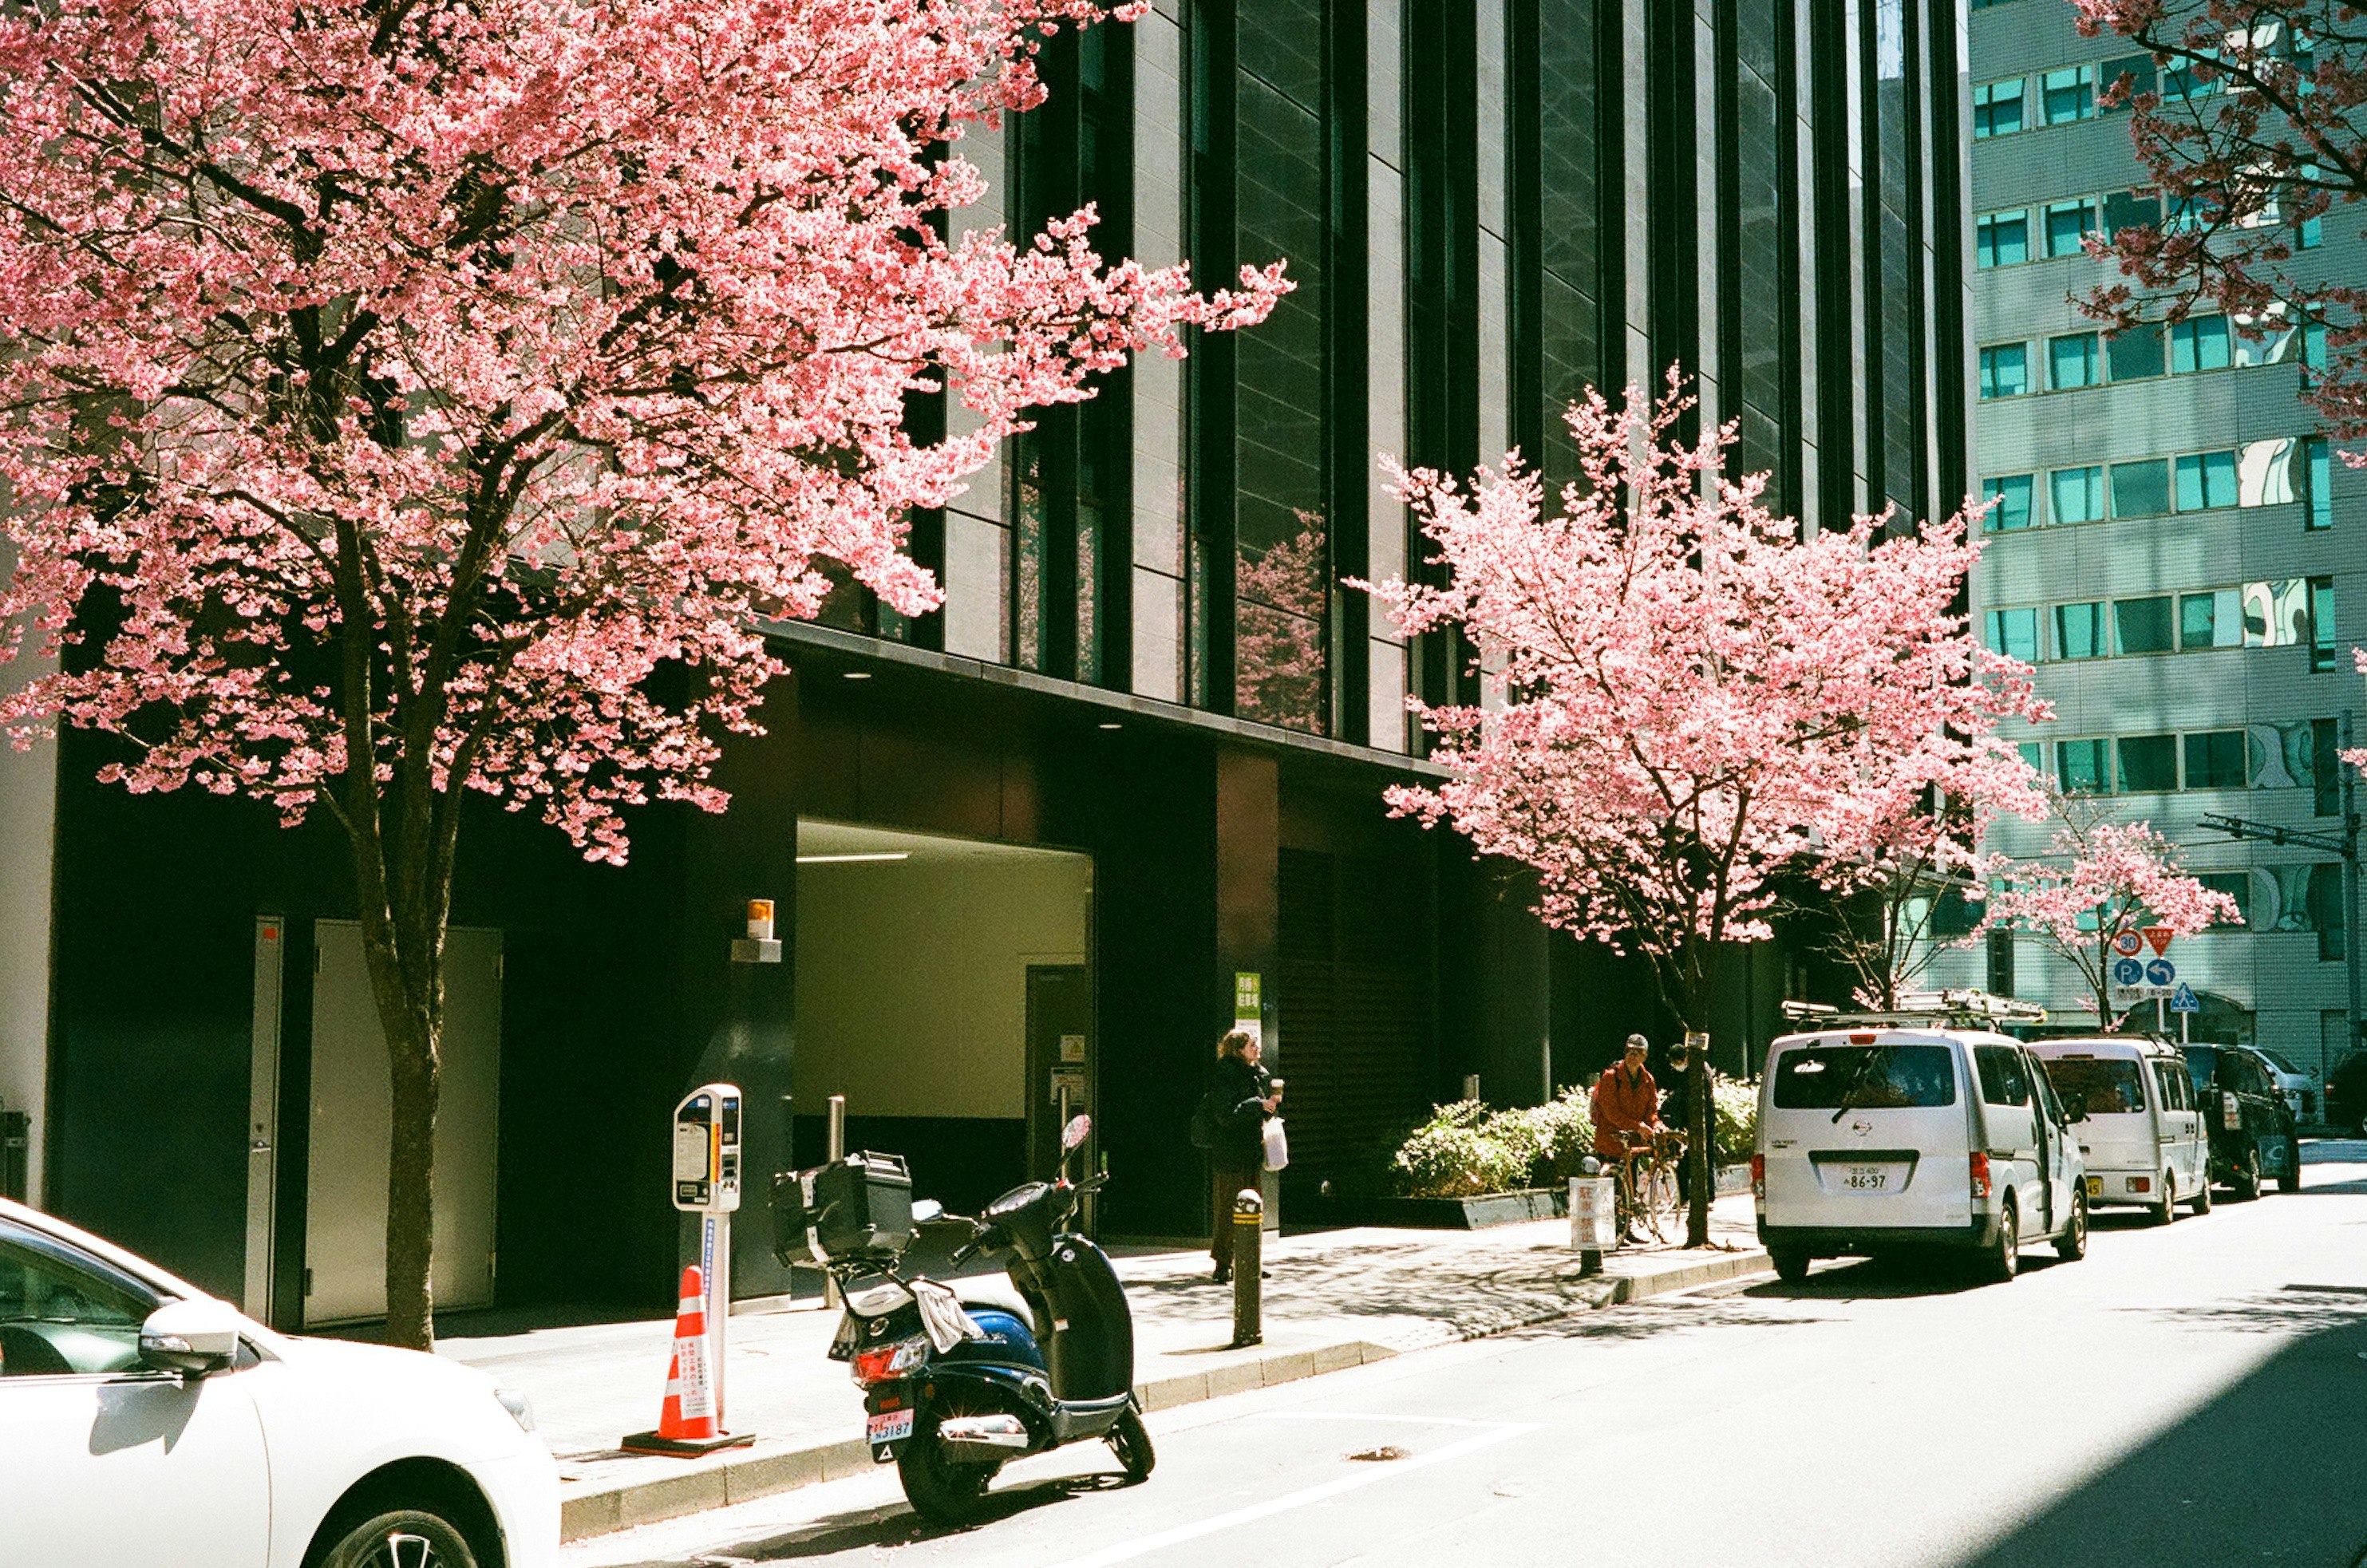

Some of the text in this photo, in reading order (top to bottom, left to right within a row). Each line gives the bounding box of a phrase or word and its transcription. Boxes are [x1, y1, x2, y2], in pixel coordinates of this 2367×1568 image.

[2120, 937, 2136, 950] 30
[1851, 1175, 1886, 1188] 86-97
[883, 1422, 910, 1438] 3187
